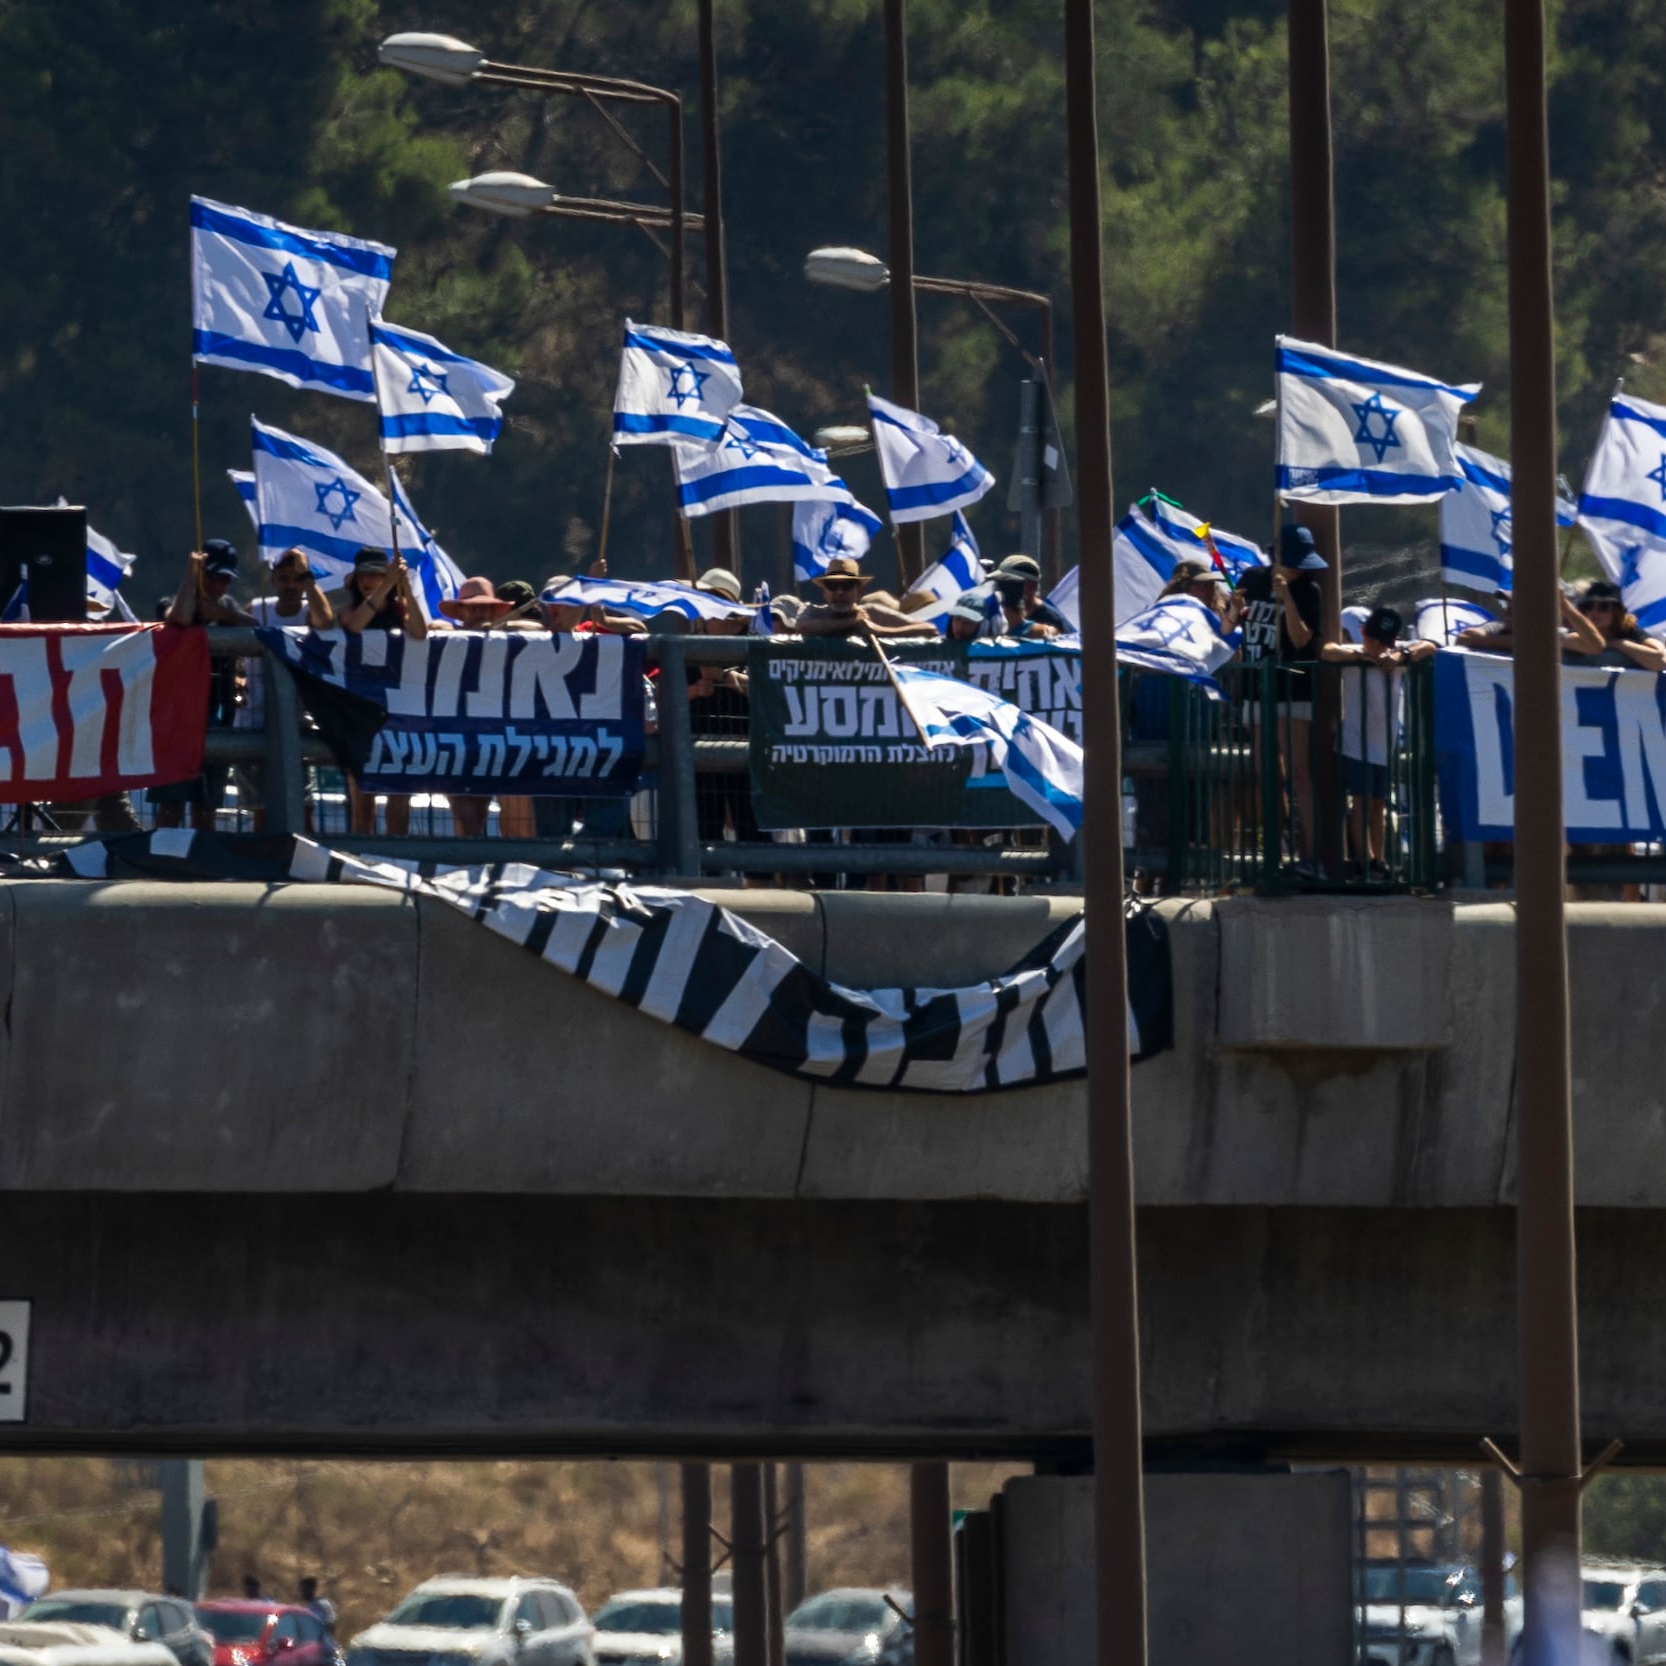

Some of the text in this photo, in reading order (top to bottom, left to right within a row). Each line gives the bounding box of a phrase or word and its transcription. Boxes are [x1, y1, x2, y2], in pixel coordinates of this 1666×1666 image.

[768, 659, 888, 683] מילואימניקים
[784, 685, 918, 737] מסע
[473, 726, 624, 778] למגילת
